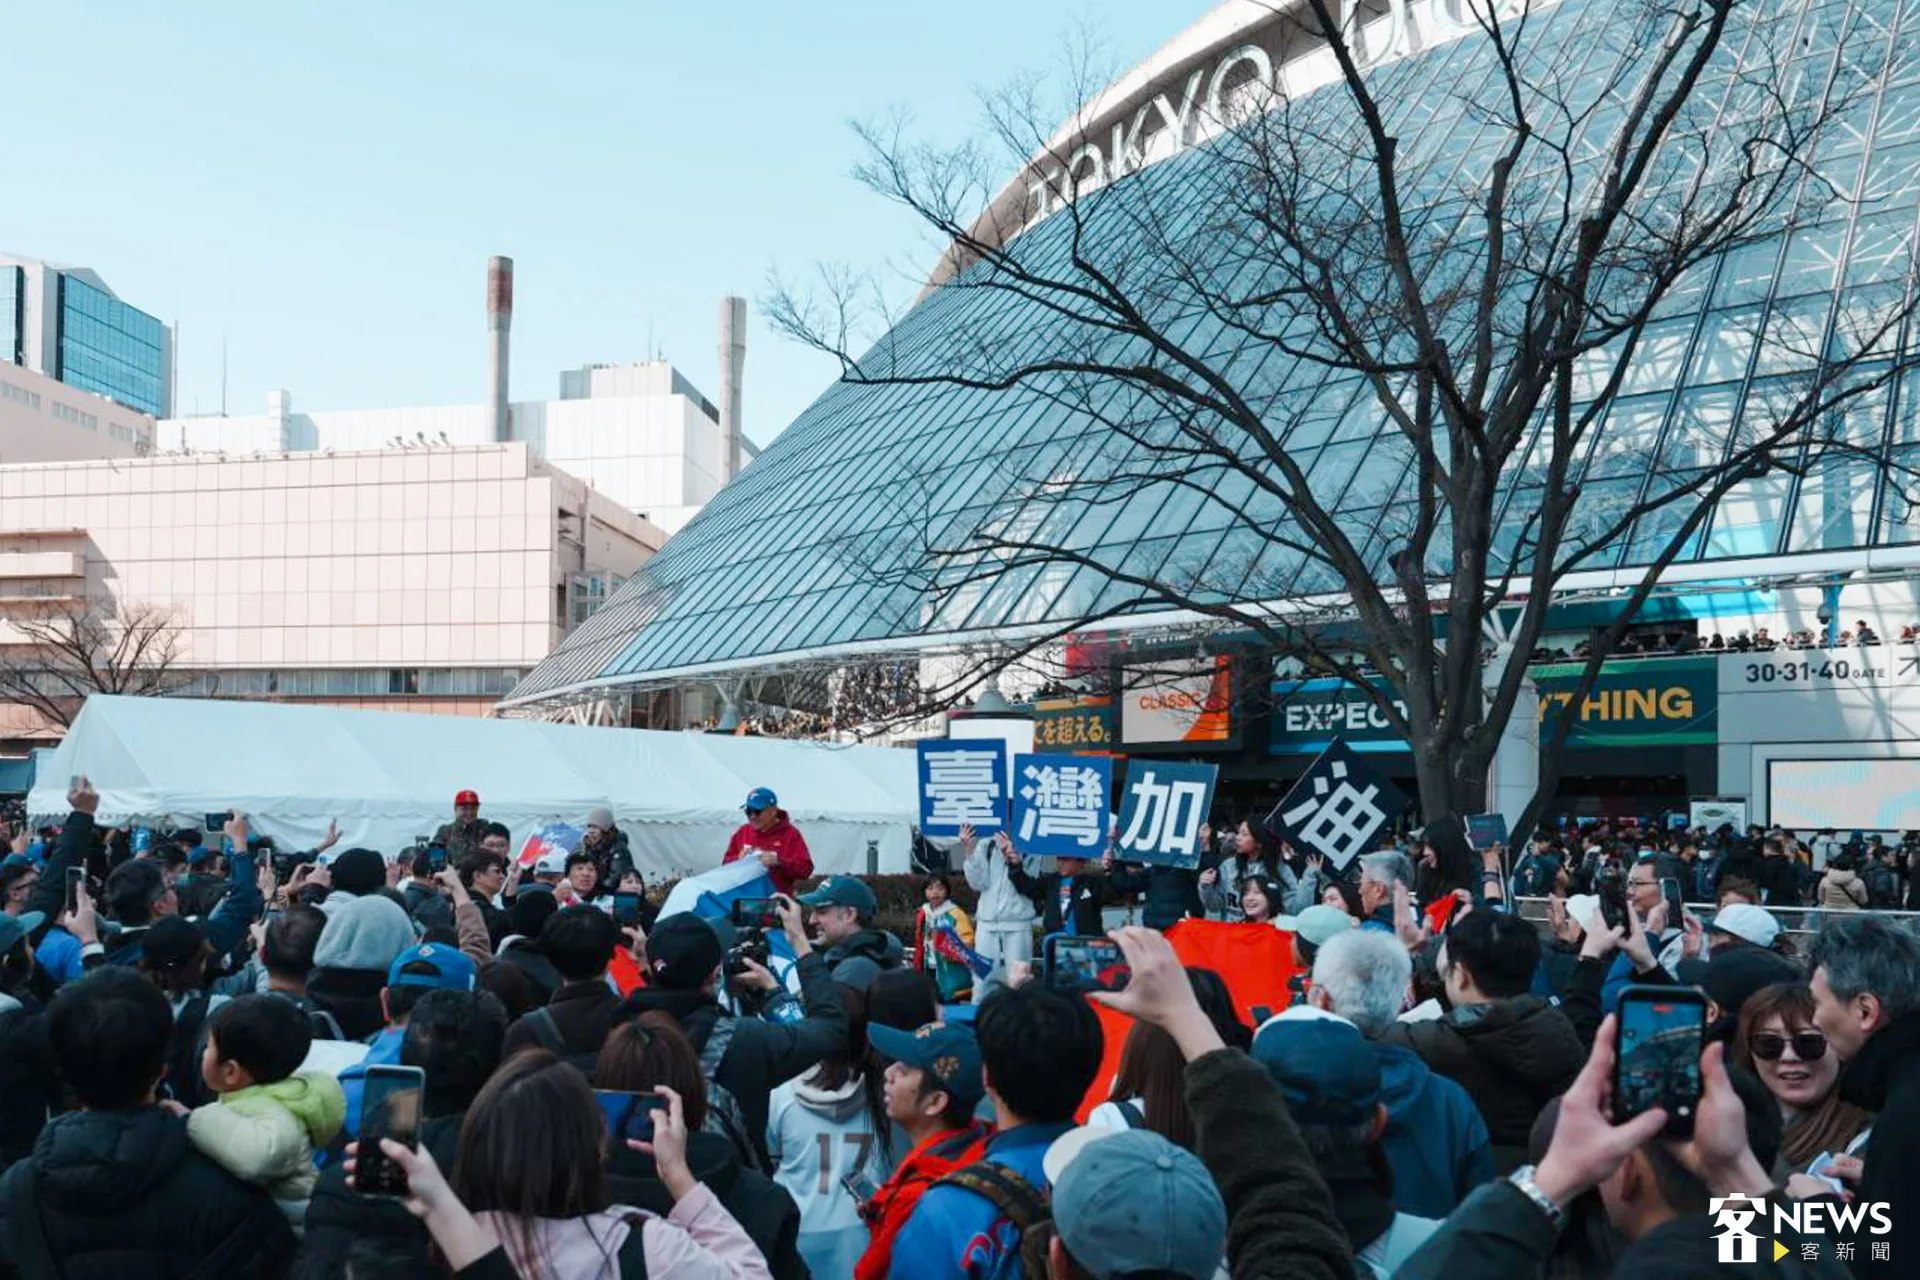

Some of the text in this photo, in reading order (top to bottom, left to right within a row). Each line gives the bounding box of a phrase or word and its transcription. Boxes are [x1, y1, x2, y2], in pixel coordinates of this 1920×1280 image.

[1029, 44, 1273, 220] TOKYO
[1852, 668, 1885, 679] GATE
[924, 749, 1001, 826] 臺
[1020, 764, 1104, 848] 灣
[1120, 771, 1207, 855] 加
[1283, 760, 1386, 872] 油
[816, 1133, 873, 1195] 17
